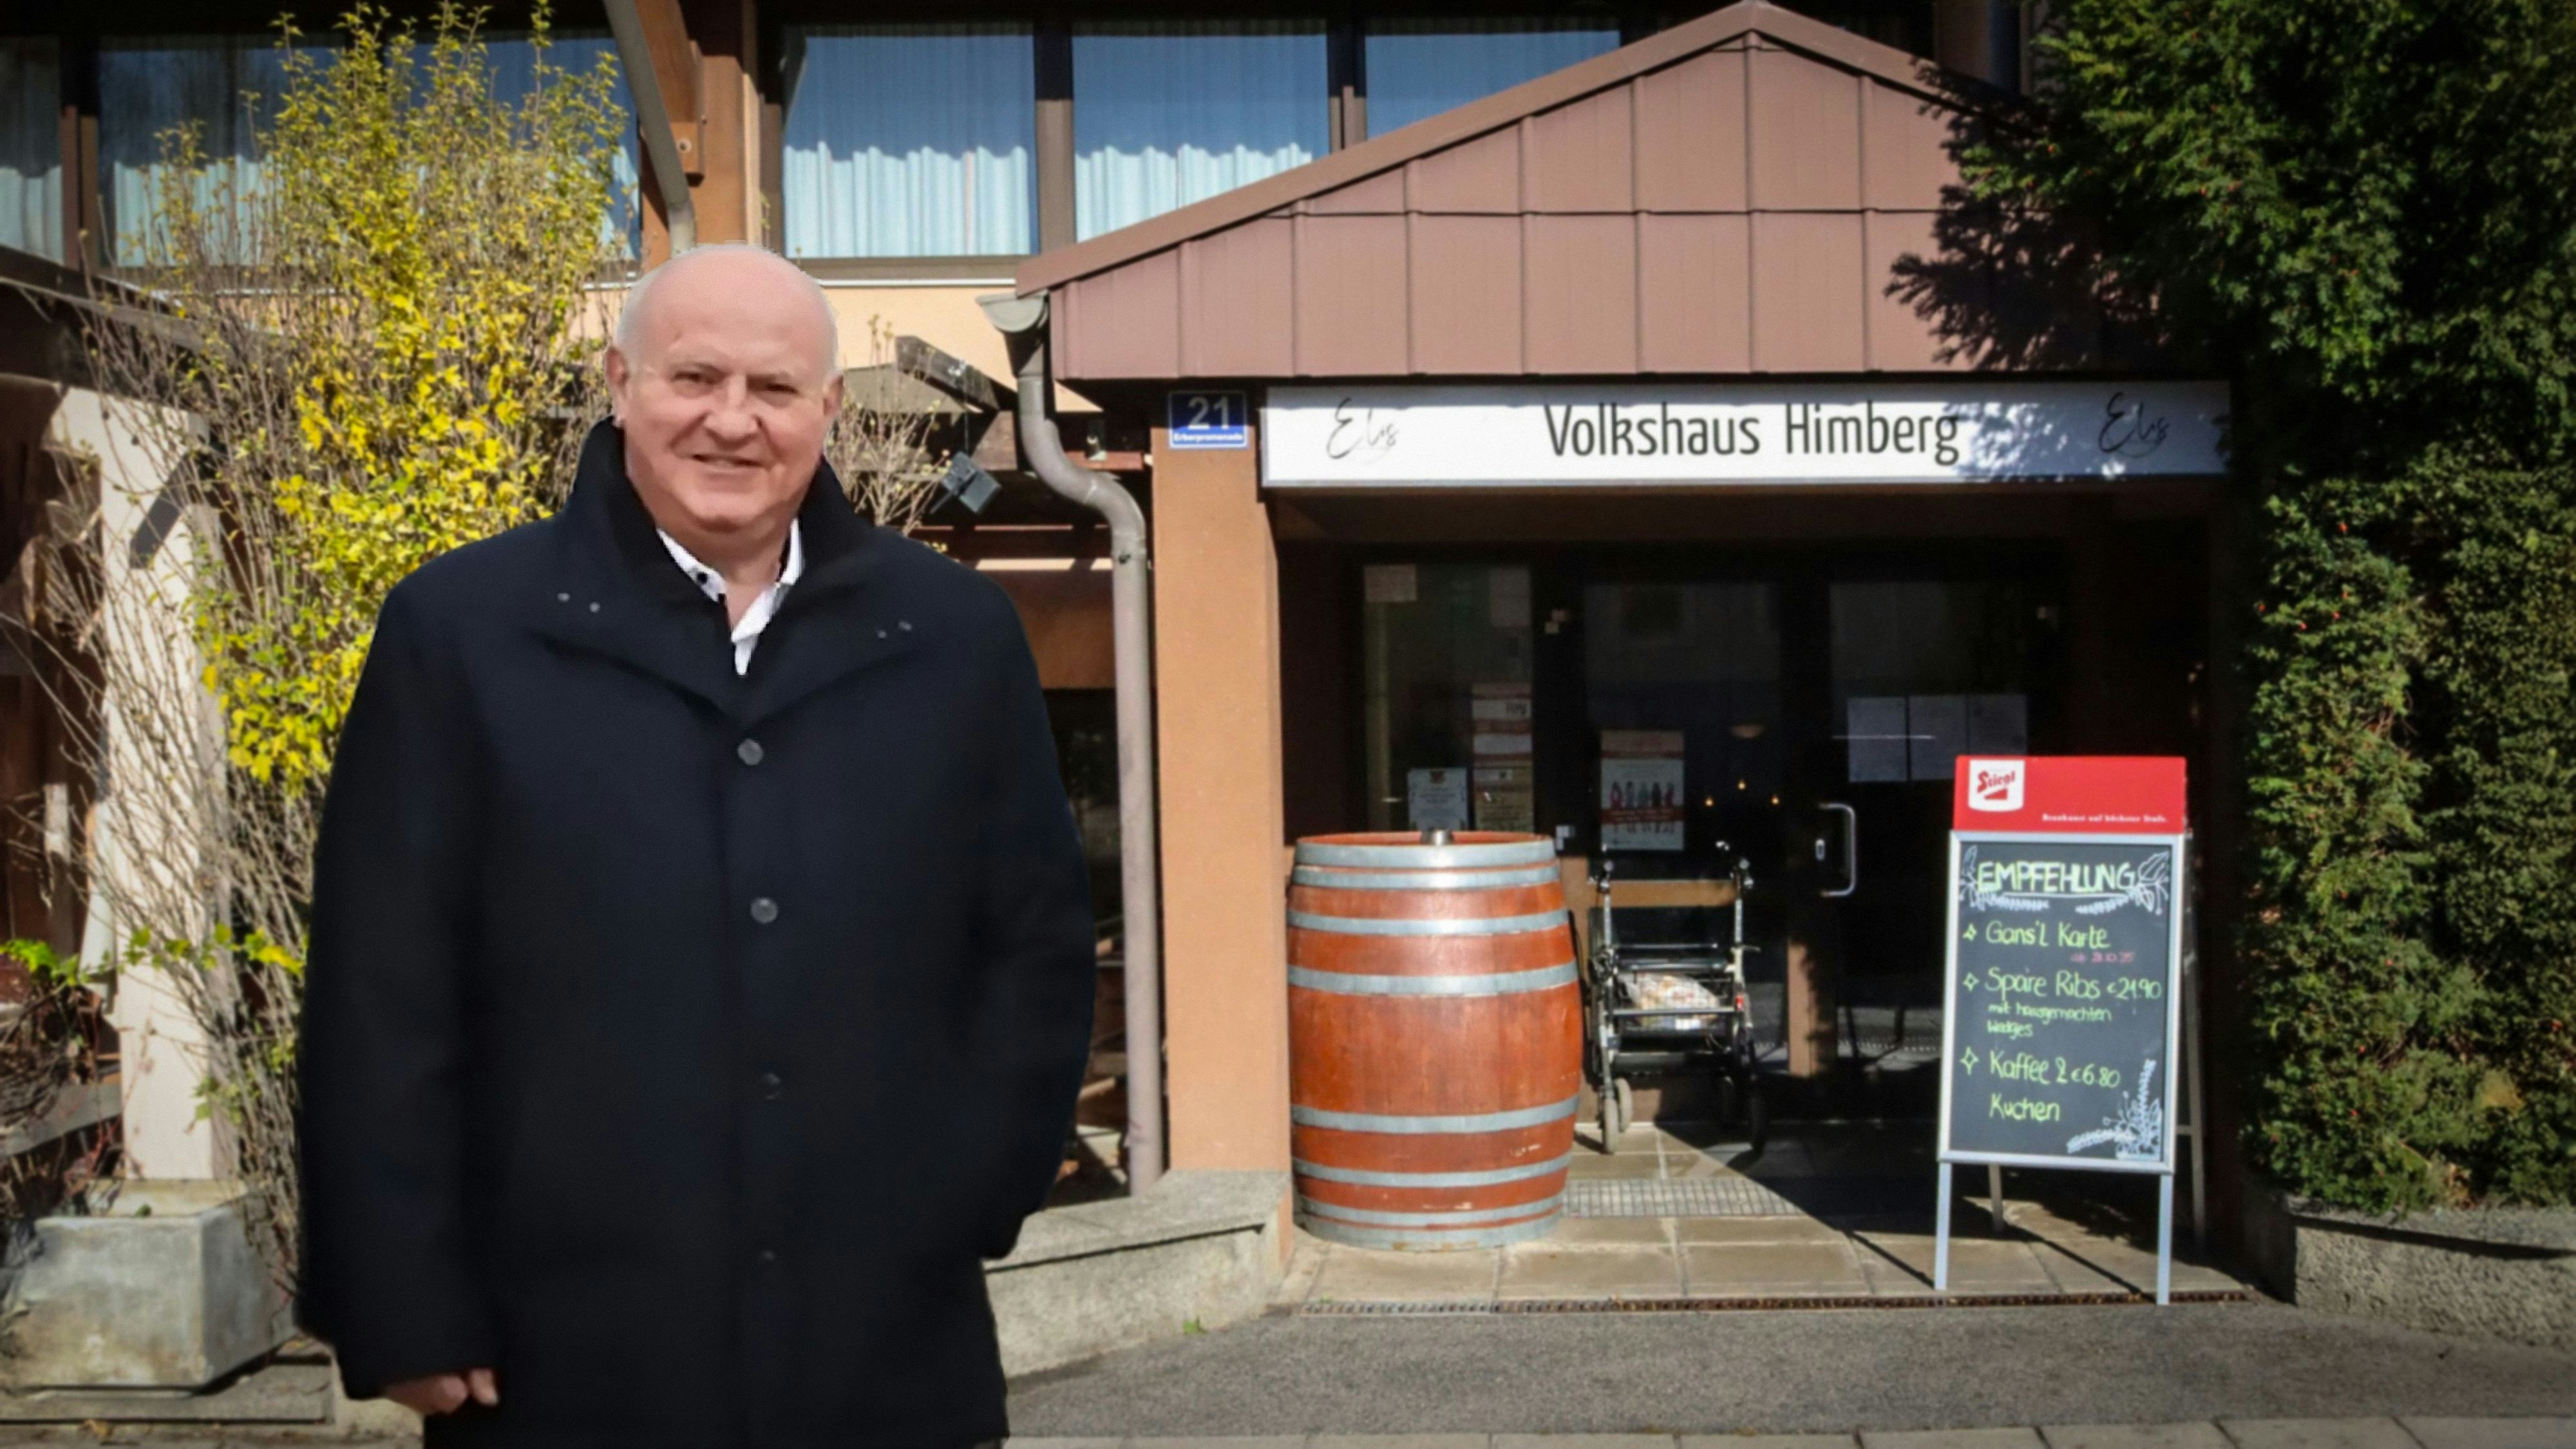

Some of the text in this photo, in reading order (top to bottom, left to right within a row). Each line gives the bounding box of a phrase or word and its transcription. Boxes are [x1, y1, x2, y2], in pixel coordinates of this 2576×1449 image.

[1188, 396, 1229, 430] 21
[1546, 400, 1960, 466] Volkshaus Himberg
[1976, 770, 2016, 793] Stiegl
[1977, 860, 2138, 893] EMPFEHLUNG
[2058, 922, 2111, 949] Karte
[1985, 967, 2047, 1001] Spare
[2056, 970, 2101, 999] Ribs
[1987, 1000, 2011, 1014] mit
[1989, 1049, 2050, 1084] Kaffee
[1989, 1094, 2060, 1122] Kuchen
